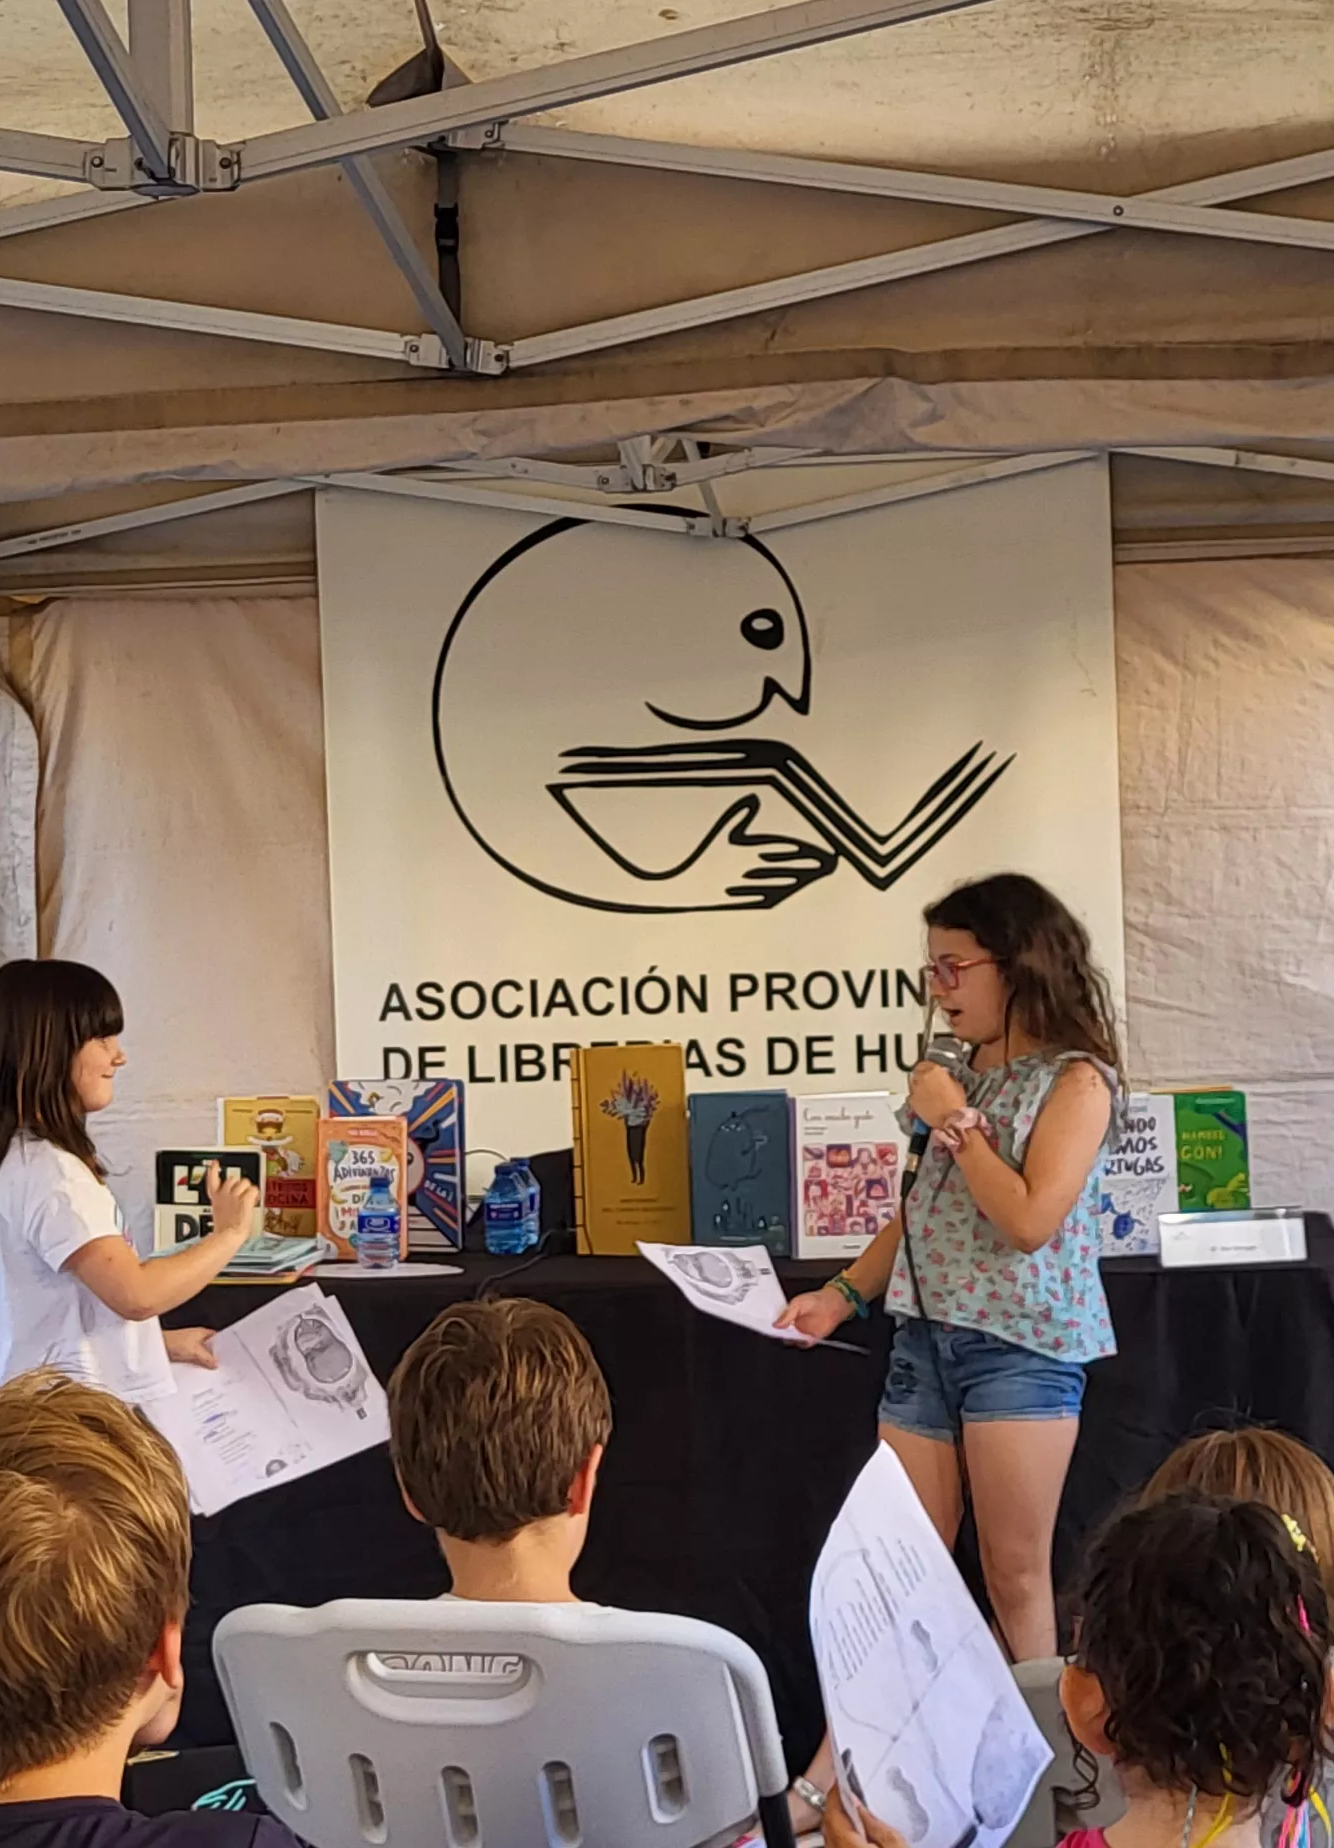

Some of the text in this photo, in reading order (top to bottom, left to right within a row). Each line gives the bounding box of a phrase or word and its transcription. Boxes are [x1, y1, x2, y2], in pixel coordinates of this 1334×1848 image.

[378, 965, 709, 1021] ASOCIACIÓN
[382, 1033, 955, 1083] DE LIBRAS DE HU
[351, 1149, 376, 1165] 365
